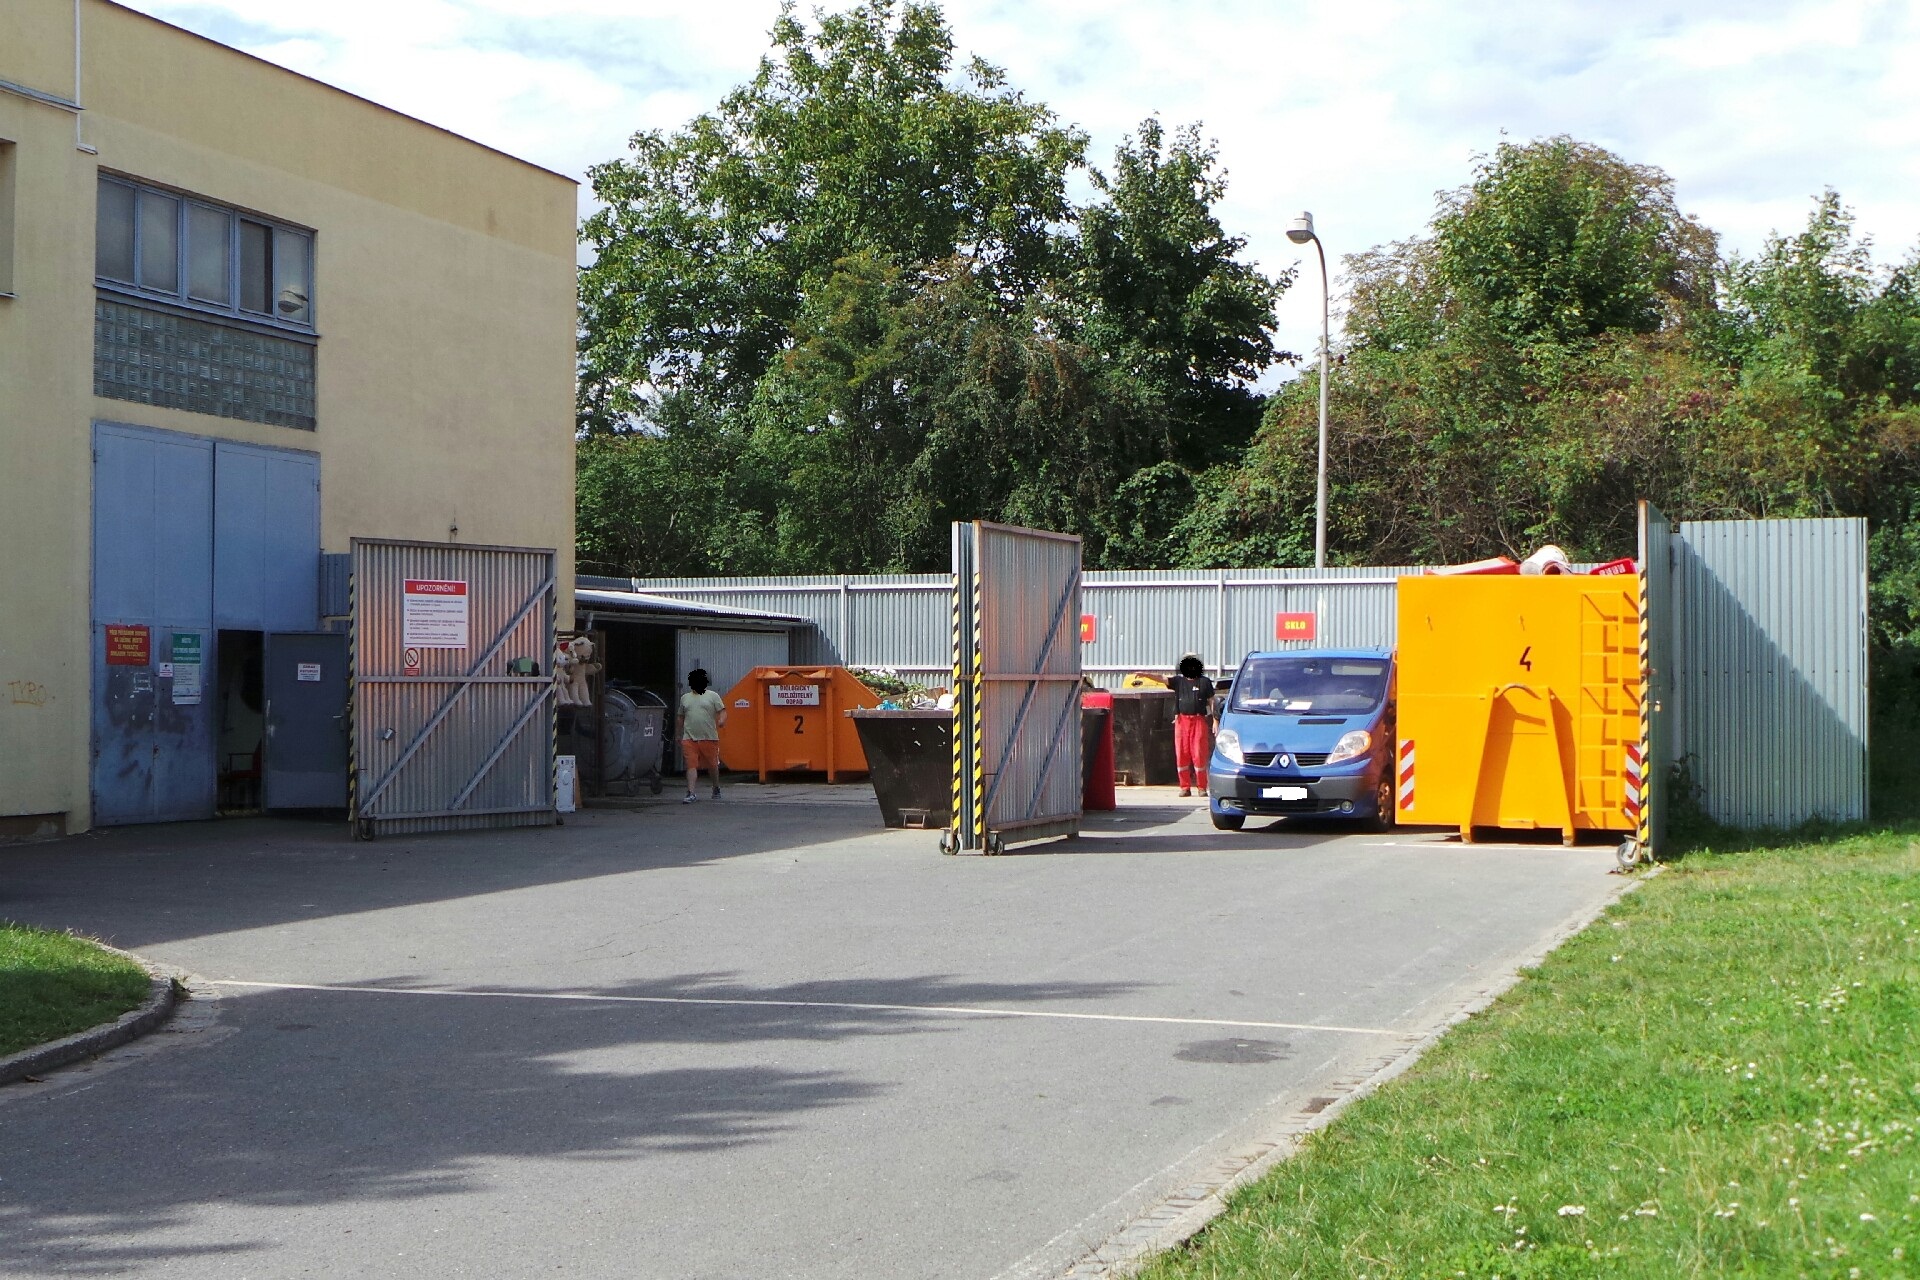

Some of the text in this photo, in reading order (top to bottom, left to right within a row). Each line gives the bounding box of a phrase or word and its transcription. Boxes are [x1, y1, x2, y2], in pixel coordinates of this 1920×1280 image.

[416, 583, 456, 593] UPOZORNĚNÍ!
[1285, 620, 1306, 630] SKLO
[1519, 646, 1532, 672] 4
[794, 715, 804, 735] 2
